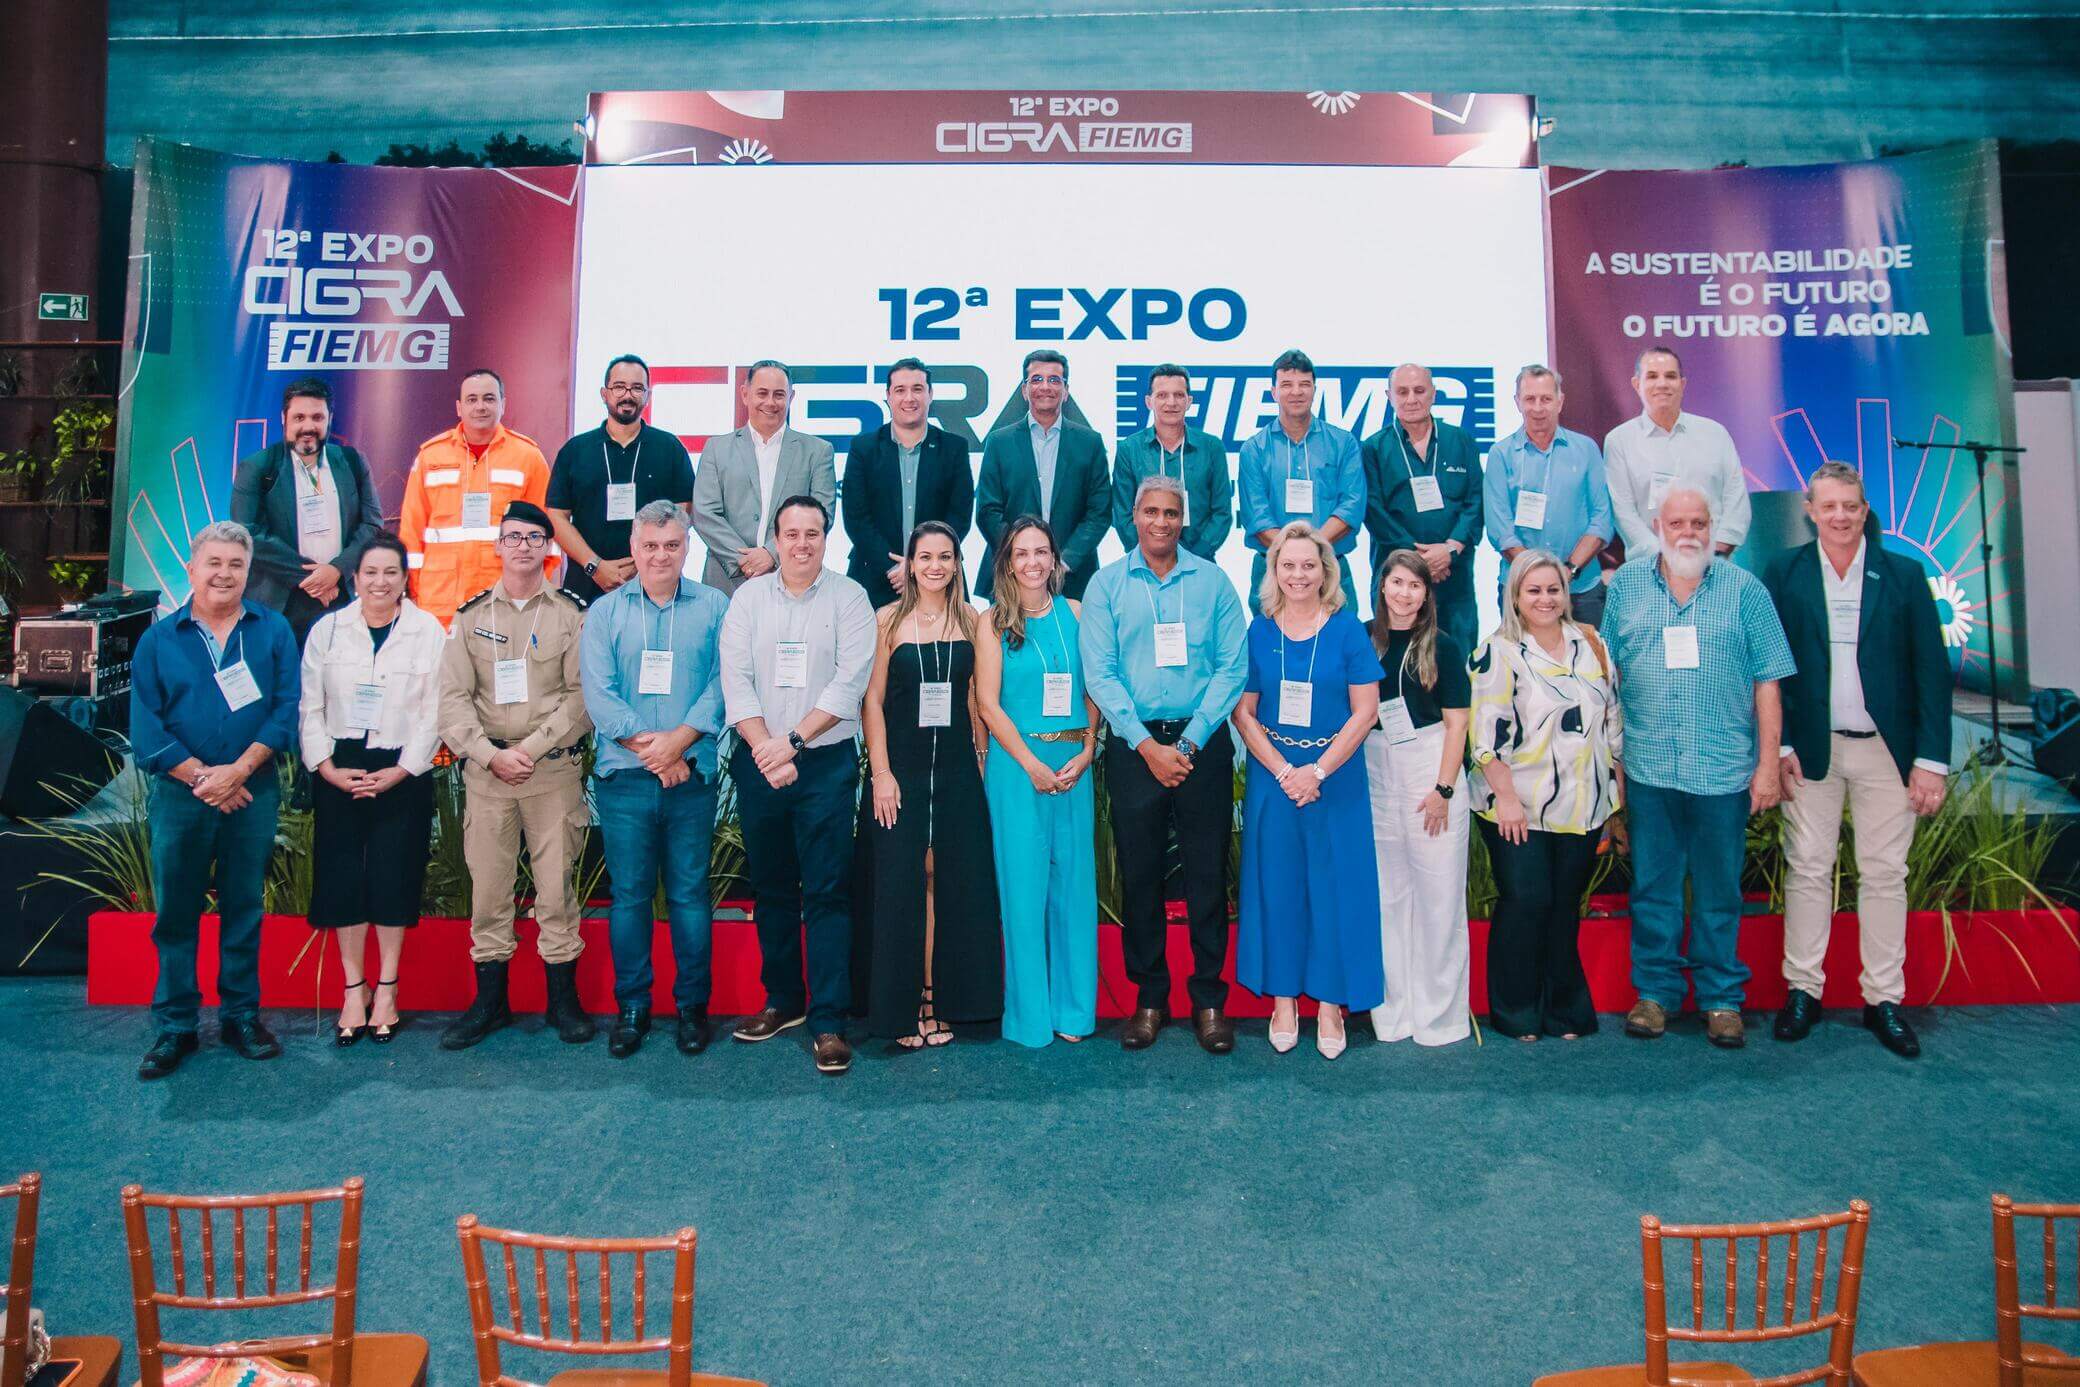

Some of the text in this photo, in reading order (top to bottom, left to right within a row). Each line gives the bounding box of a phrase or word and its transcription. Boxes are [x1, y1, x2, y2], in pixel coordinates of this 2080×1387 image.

[1049, 97, 1119, 117] EXPO
[936, 122, 1184, 152] CIGRA FIEMG
[321, 231, 434, 264] EXPO
[1585, 244, 1912, 275] A SUSTENTABILIDADE
[244, 266, 465, 317] CIGRA
[1700, 276, 1891, 305] É O FUTURO
[1015, 287, 1248, 342] EXPO
[1623, 305, 1930, 337] O FUTURO É AGORA
[280, 329, 436, 364] FIEMG
[1146, 376, 1468, 442] IEM
